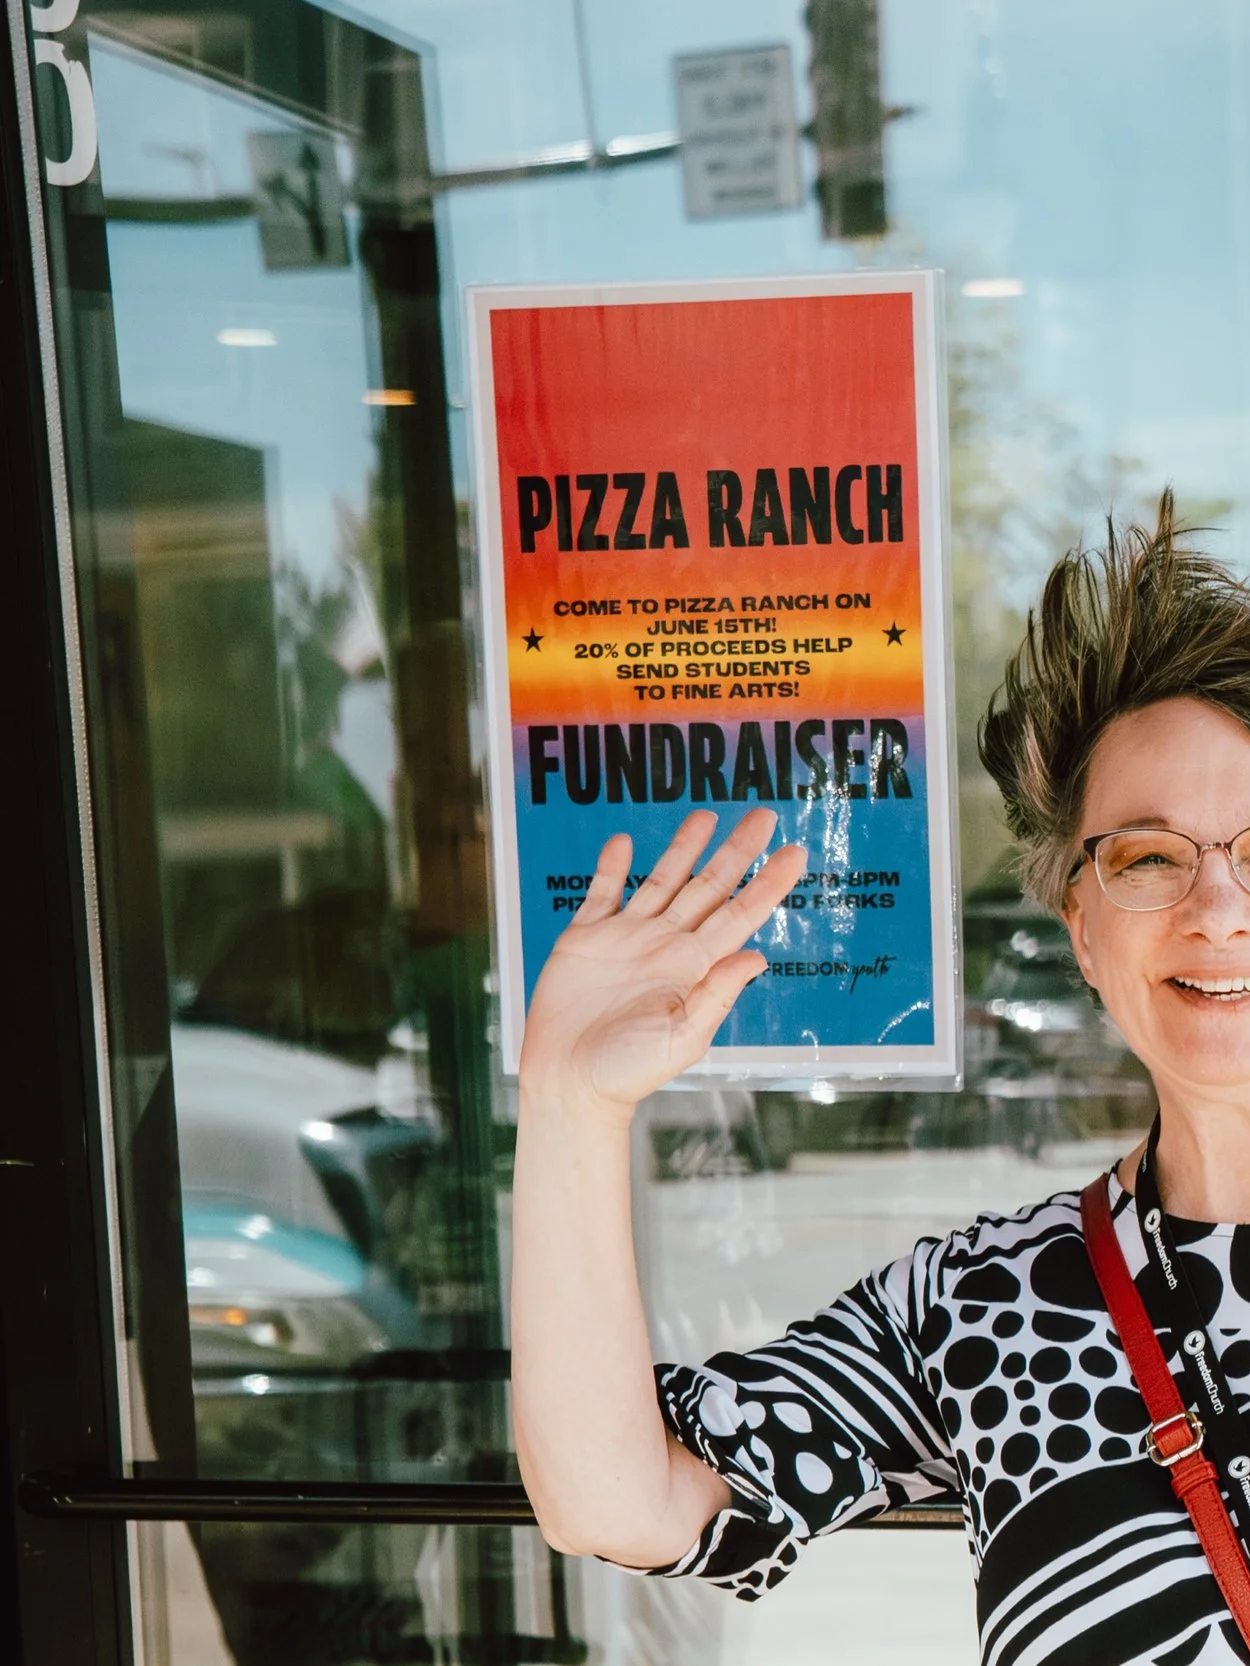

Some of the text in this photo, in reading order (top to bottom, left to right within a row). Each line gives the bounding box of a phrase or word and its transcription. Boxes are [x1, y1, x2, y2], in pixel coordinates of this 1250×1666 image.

[517, 464, 904, 553] PIZZA RANCH
[554, 592, 871, 617] COME TO PIZZA RANCH ON
[647, 617, 777, 636] JUNE 15TH!
[574, 637, 853, 659] 20% OF PROCEEDS HELP
[616, 659, 811, 680] SEND STUDENTS
[634, 681, 800, 701] TO FINE ARTS!
[528, 719, 914, 806] FUNDRAISER
